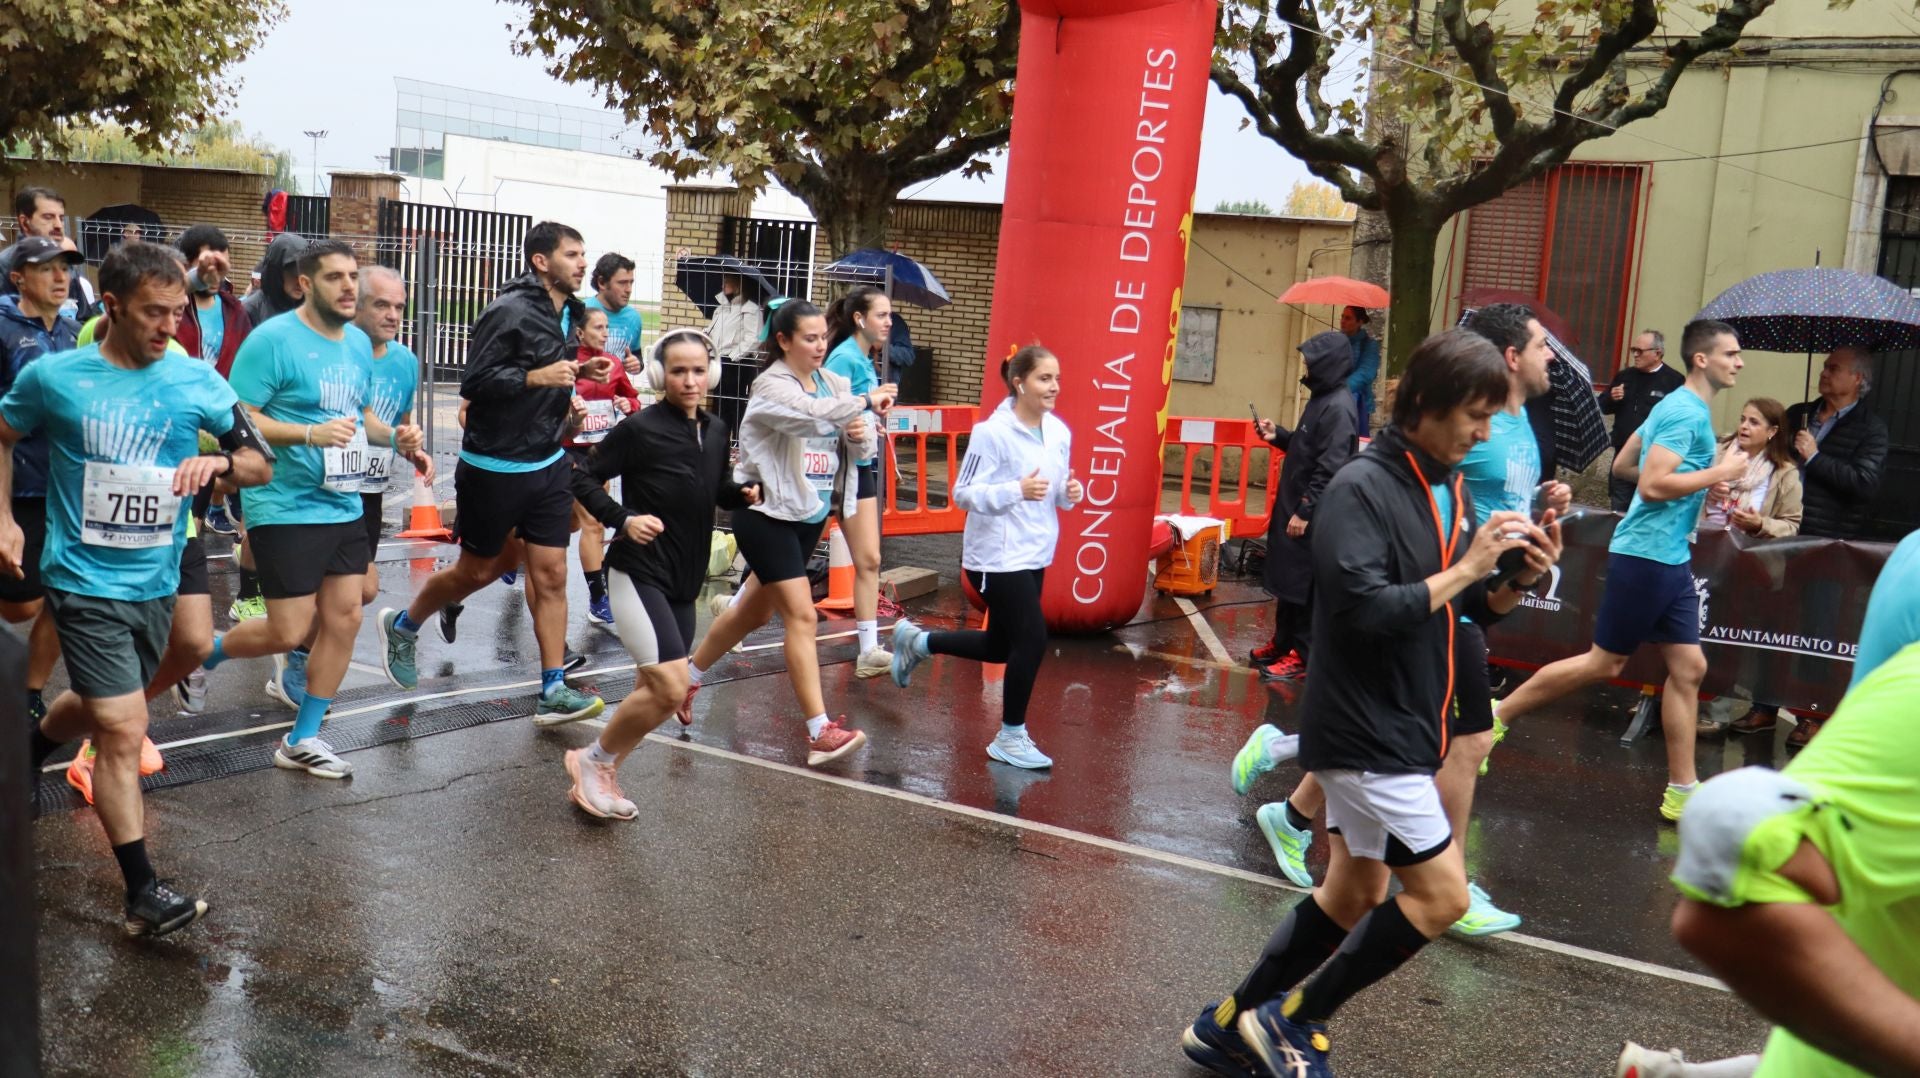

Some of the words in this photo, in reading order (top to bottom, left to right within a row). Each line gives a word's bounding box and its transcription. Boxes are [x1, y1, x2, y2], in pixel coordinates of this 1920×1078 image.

[1119, 48, 1177, 263] DEPORTES
[1109, 280, 1146, 334] DE
[1072, 353, 1136, 604] CONCEJALÍA
[107, 493, 160, 525] 766
[1709, 626, 1833, 652] AYUNTAMIENTO
[1837, 642, 1859, 656] DE
